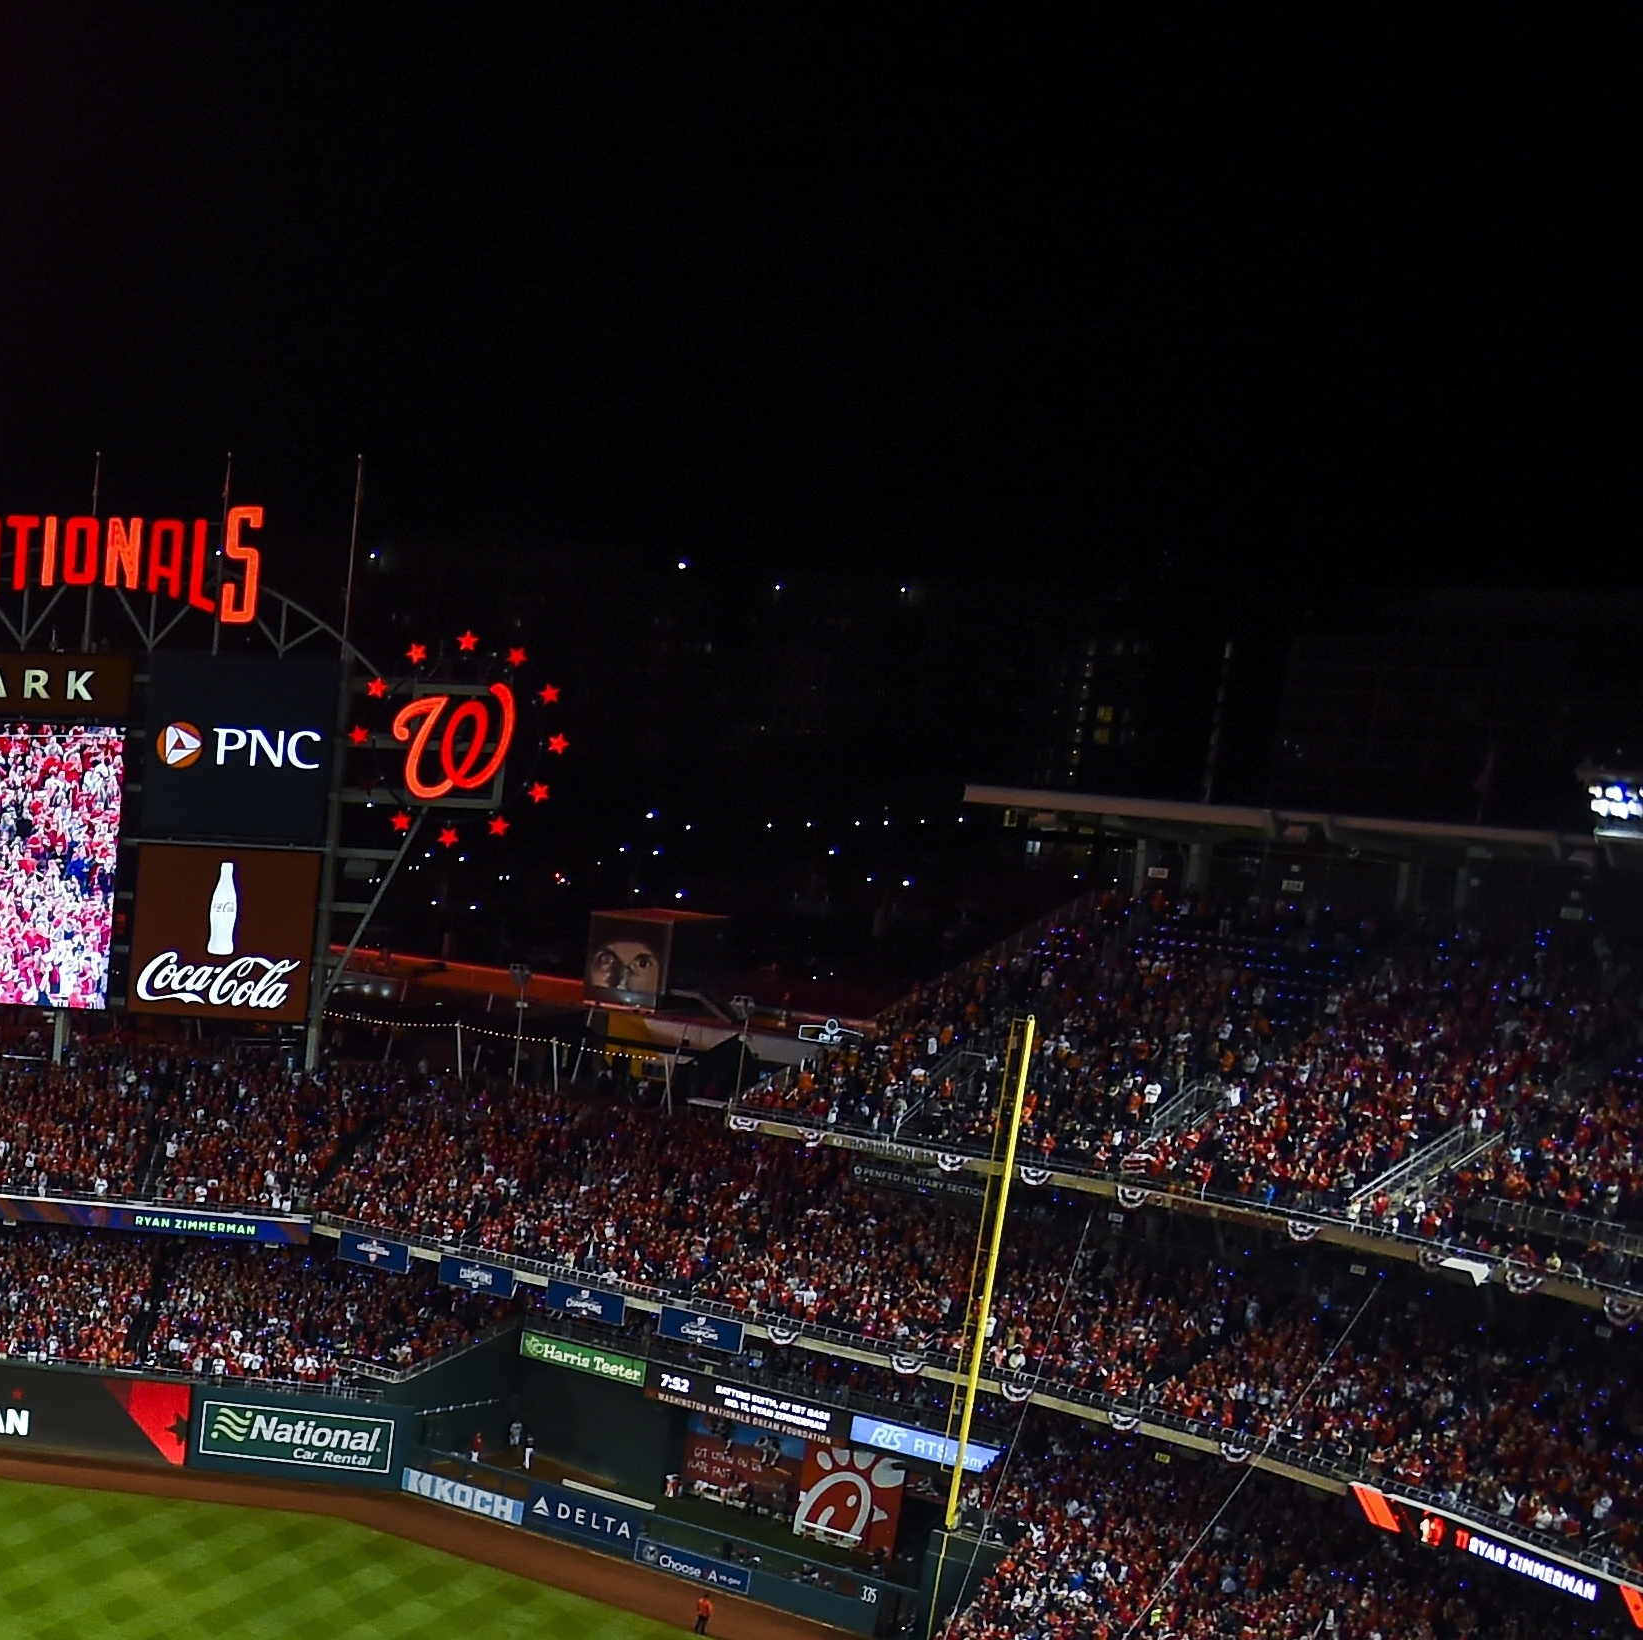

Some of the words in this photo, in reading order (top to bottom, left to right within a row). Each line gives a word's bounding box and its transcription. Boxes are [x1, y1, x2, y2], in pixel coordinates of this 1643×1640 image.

[212, 727, 322, 770] PNC
[392, 683, 516, 800] W
[137, 951, 301, 1009] Coca-Cola
[863, 1166, 900, 1182] PENFED
[902, 1173, 945, 1190] MILITARY
[135, 1215, 170, 1228] RYAN
[174, 1219, 256, 1235] ZIMMERMAN
[542, 1342, 591, 1373] Harris
[593, 1356, 642, 1383] Teeter
[660, 1373, 690, 1394] 7:52
[249, 1415, 379, 1453] National
[658, 1392, 708, 1413] WASHINGTON
[708, 1405, 751, 1425] NATIONALS
[752, 1418, 781, 1433] DREAM
[781, 1424, 832, 1445] FOUNDATION
[293, 1447, 319, 1461] Car
[322, 1451, 372, 1467] Rental
[433, 1479, 514, 1521] KOCH
[555, 1501, 632, 1540] DELTA
[660, 1554, 702, 1578] Choose
[1469, 1538, 1508, 1565] RYAN
[1508, 1553, 1597, 1601] ZIMMERMAN
[860, 1585, 878, 1604] 335
